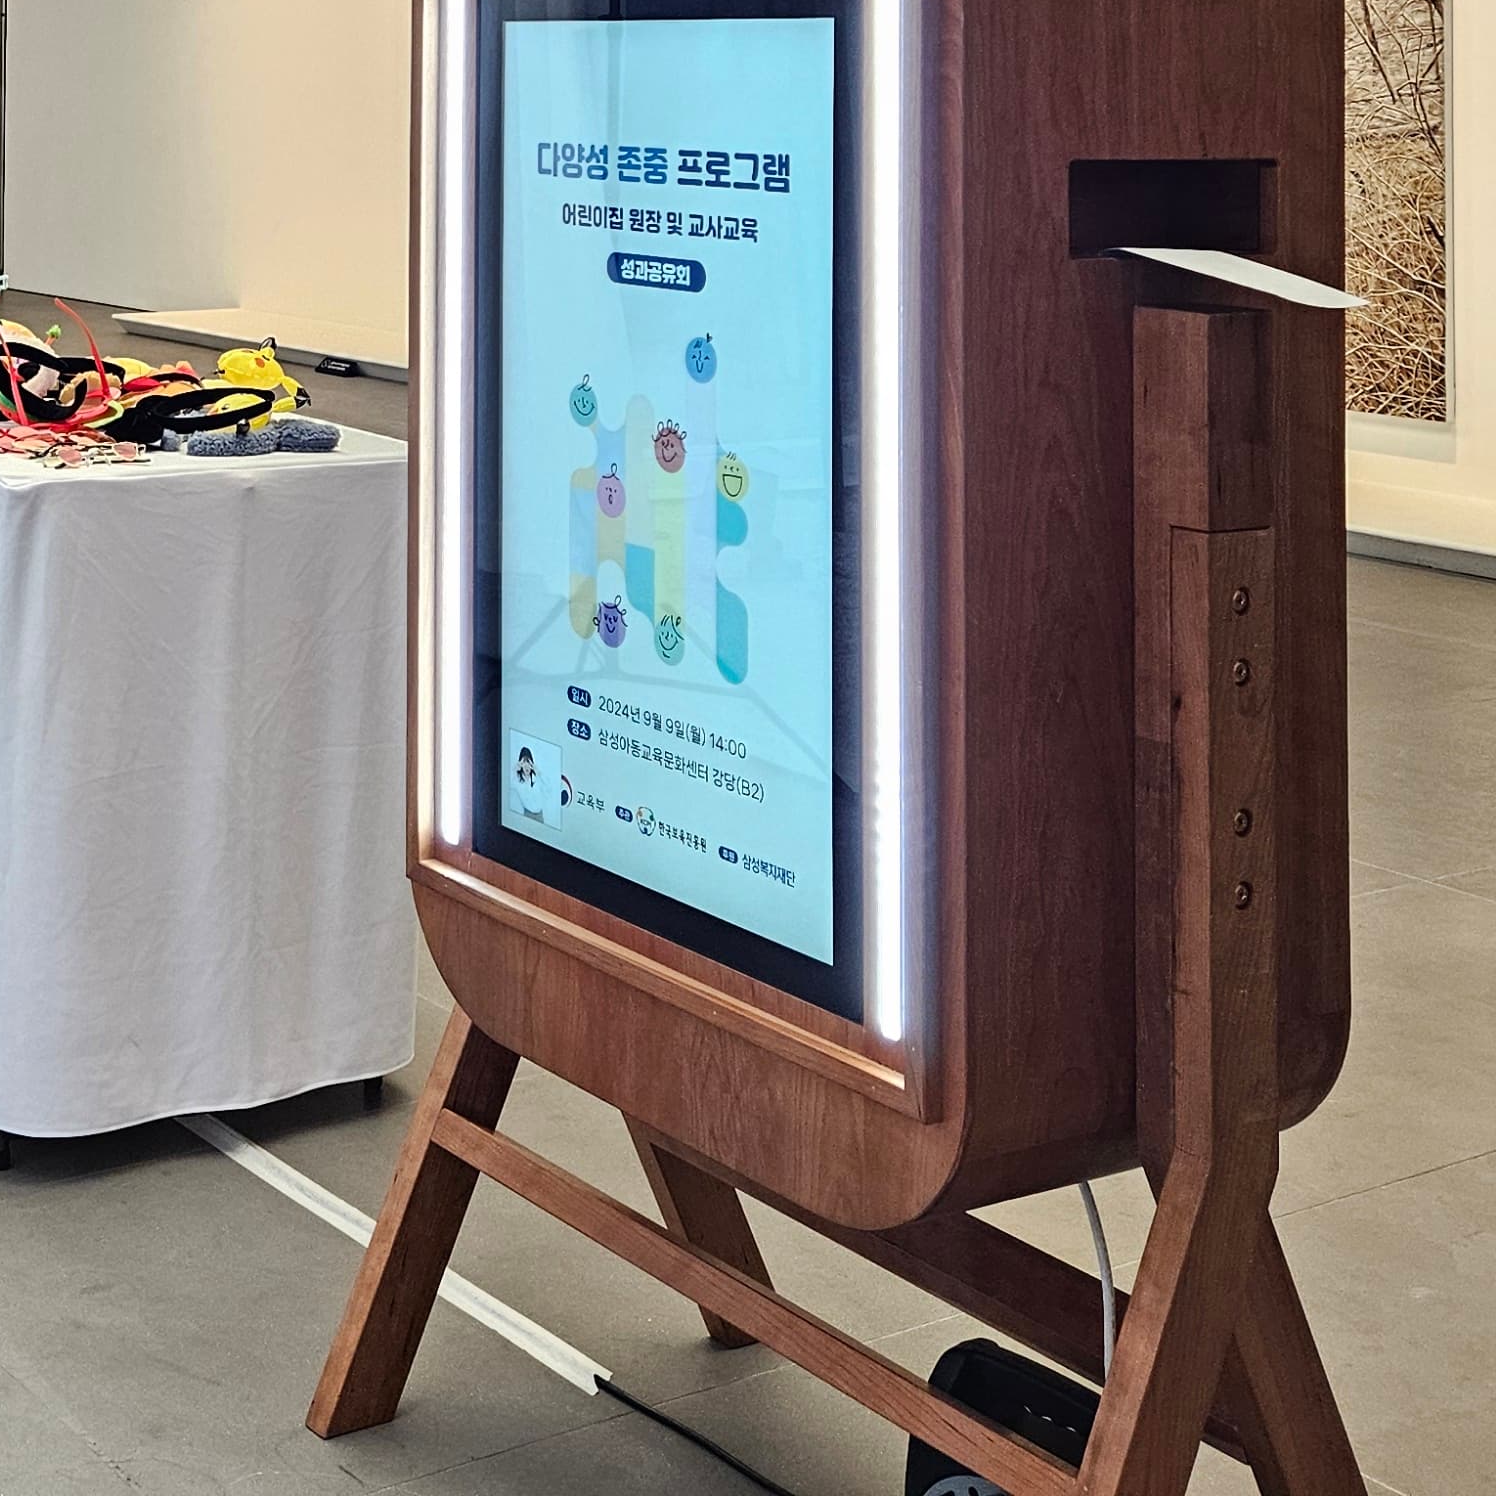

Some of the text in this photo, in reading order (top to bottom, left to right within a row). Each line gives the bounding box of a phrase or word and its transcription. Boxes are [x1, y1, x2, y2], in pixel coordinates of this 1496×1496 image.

[537, 142, 791, 193] 다양성 존중 프로그램
[562, 202, 758, 243] 어린이집 원장 및 교사교육
[620, 258, 691, 286] 성과공유회
[571, 688, 747, 759] 일시 2024년 9월 9일(월) 14:00
[571, 720, 765, 803] 장소 삼성아동교육문화센터 강당(B2)
[577, 790, 605, 812] 교육부
[658, 820, 707, 853] 한국보육진흥원
[742, 853, 796, 889] 삼성복지재단
